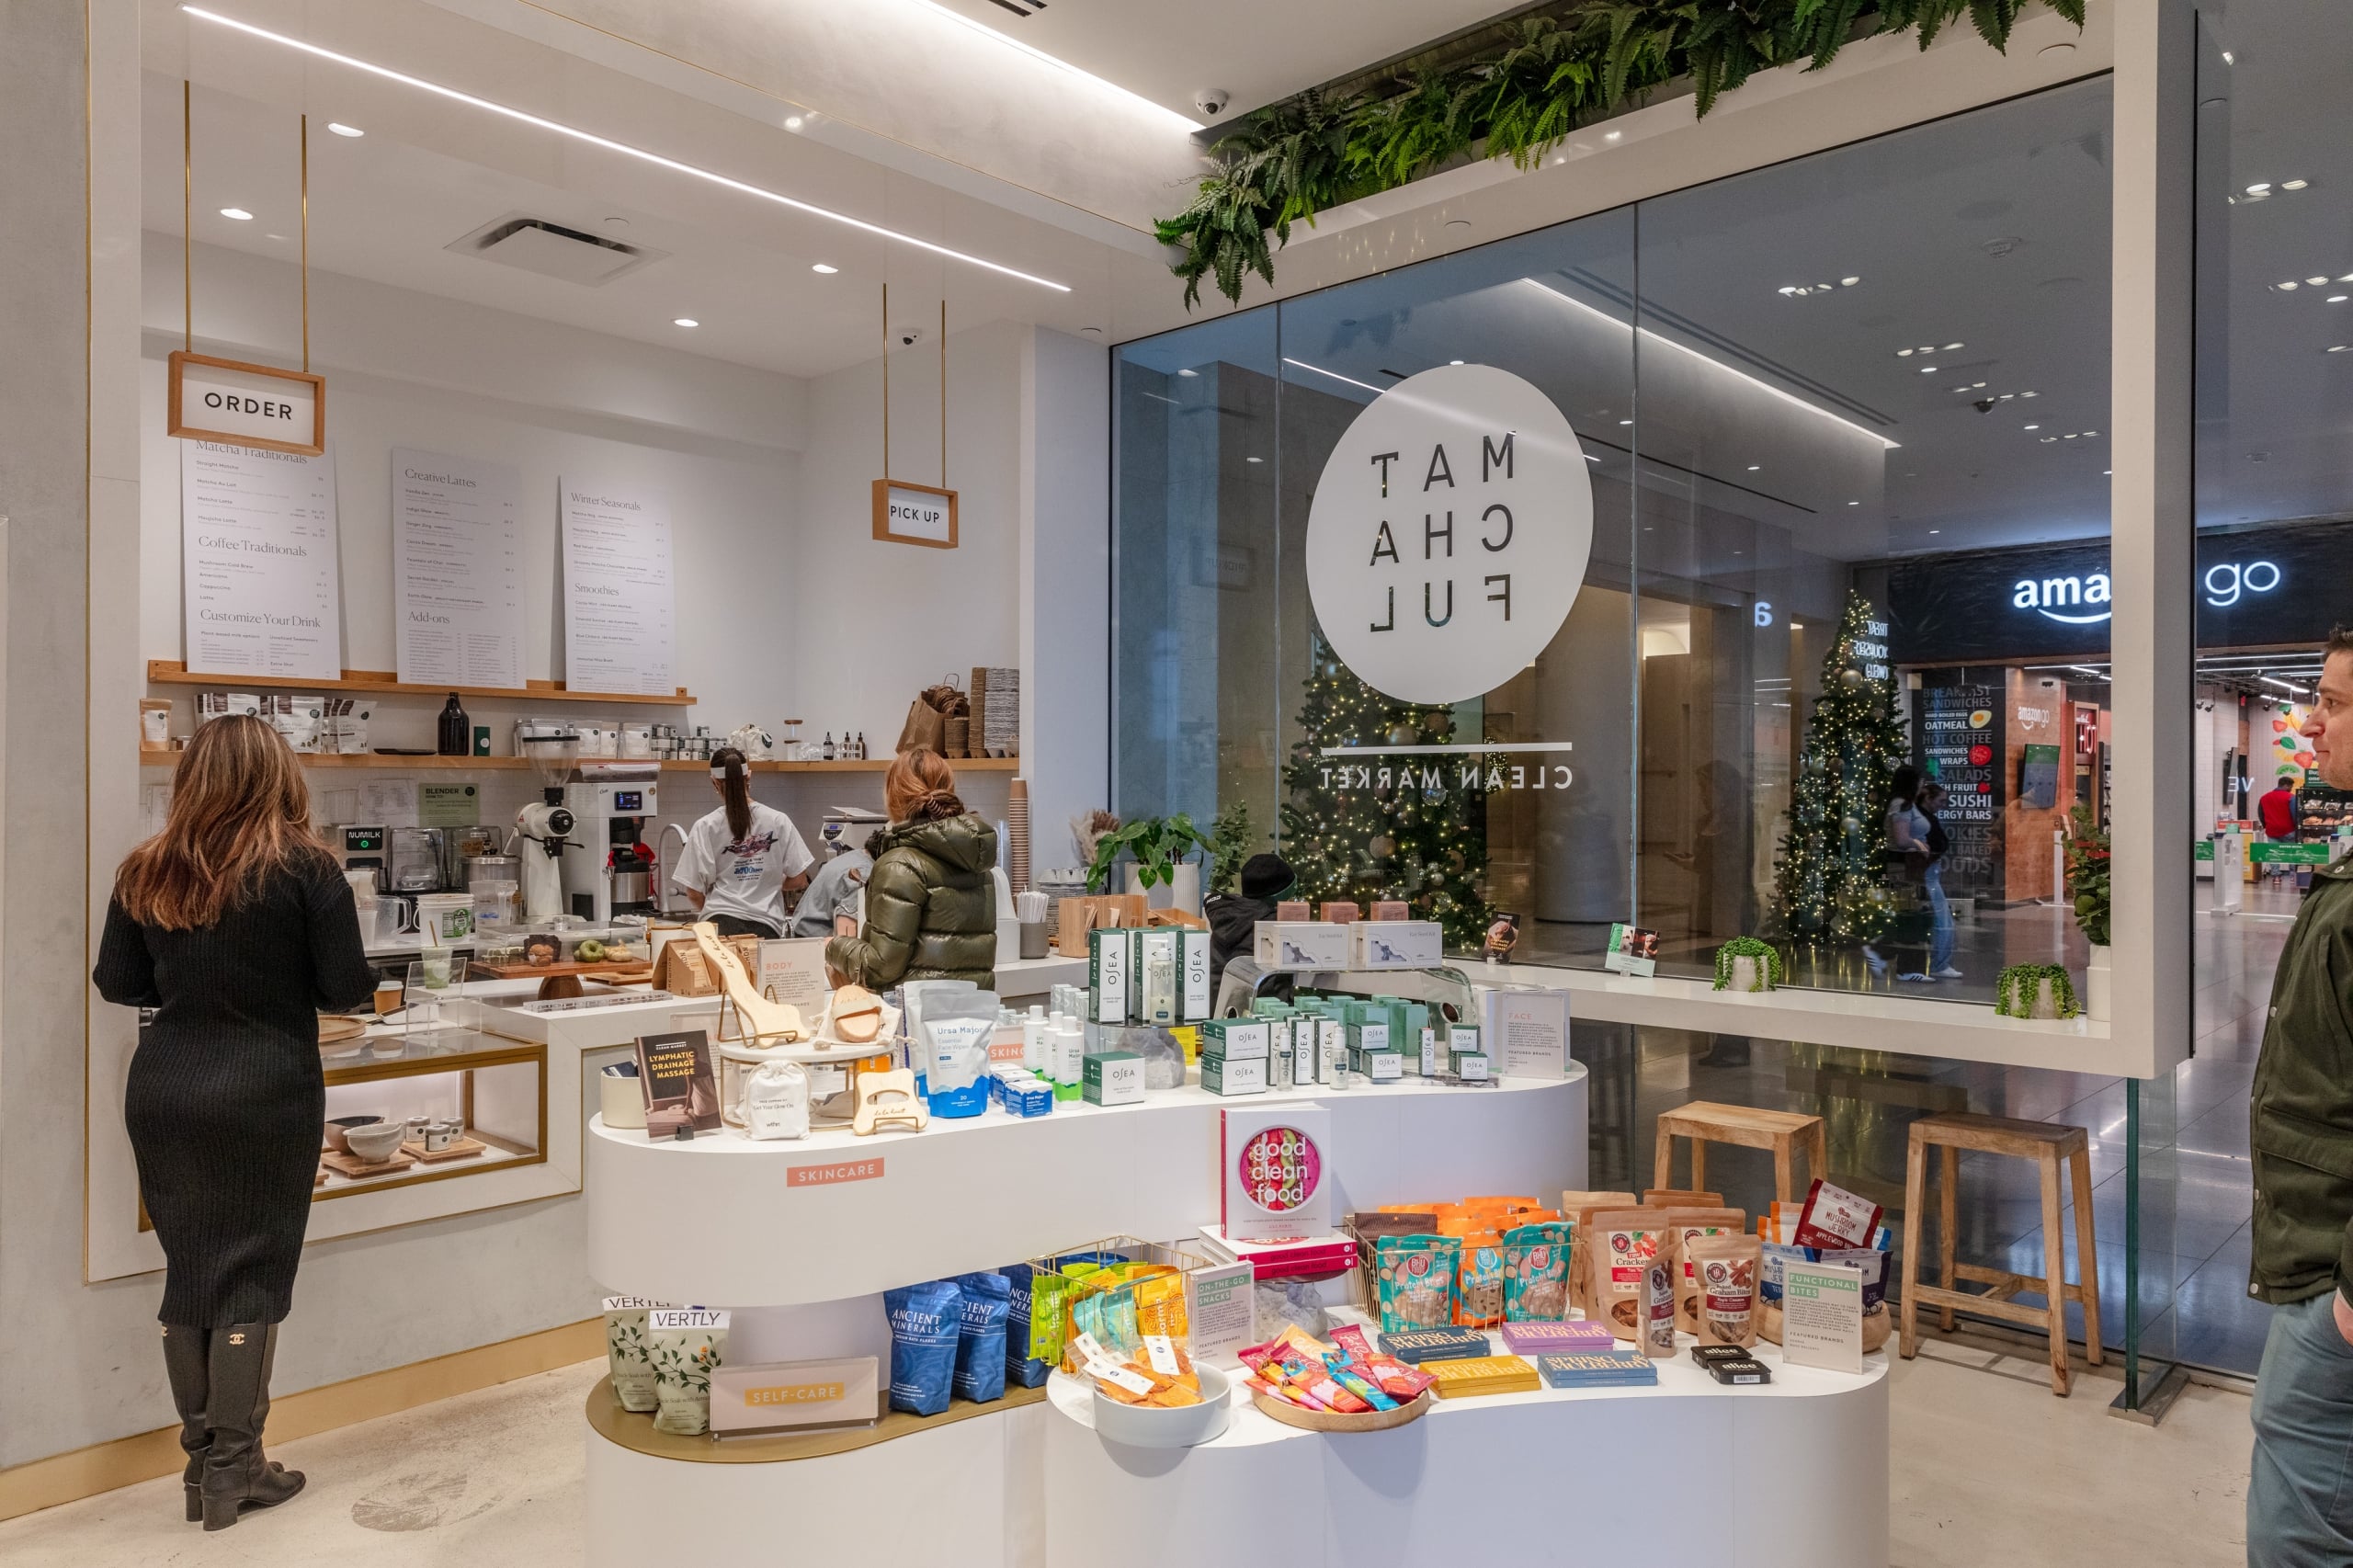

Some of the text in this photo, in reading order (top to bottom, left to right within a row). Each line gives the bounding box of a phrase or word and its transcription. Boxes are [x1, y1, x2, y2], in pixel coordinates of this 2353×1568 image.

[204, 392, 291, 420] ORDER
[196, 439, 240, 456] Matcha
[405, 469, 477, 488] Creative Lattes
[571, 492, 641, 511] Winter Seasonals
[891, 506, 939, 522] PICK UP
[199, 536, 307, 556] Coffee Traditionals
[575, 583, 619, 596] Smoothies
[2205, 561, 2280, 606] go
[2013, 574, 2111, 608] ama
[200, 609, 322, 628] Customize Your Drink
[408, 611, 450, 624] Add-ons
[1924, 698, 1992, 709] SANDWICHES
[2018, 706, 2040, 722] amazon
[1926, 721, 1968, 730] OATMEAL
[1923, 733, 1992, 744] HOT COFFEE
[1939, 769, 1992, 781] SALADS
[1949, 795, 1992, 808] SUSHI
[1934, 811, 1992, 820] ERGY BARS
[1947, 827, 1992, 840] OKIES
[1940, 857, 1992, 873] OODS
[767, 962, 792, 971] BODY
[649, 1051, 695, 1062] LYMPHATIC
[992, 1049, 1024, 1057] SKINC
[652, 1060, 695, 1071] DRAINAGE
[657, 1068, 695, 1079] MASSAGE
[1253, 1137, 1306, 1161] good
[799, 1164, 874, 1182] SKINCARE
[1251, 1161, 1308, 1180] clean
[1256, 1182, 1303, 1202] food
[1825, 1211, 1857, 1231] MUSHROOM
[1828, 1223, 1850, 1236] JERKY
[1816, 1232, 1843, 1247] APPLEWOOD
[1764, 1265, 1782, 1274] MUSHR
[1199, 1277, 1245, 1291] ON-THE-GO
[1790, 1274, 1856, 1290] FUNCTIONAL
[1010, 1290, 1030, 1303] NCIE
[1199, 1292, 1230, 1304] SNACKS
[1790, 1287, 1817, 1296] BITES
[962, 1301, 994, 1315] CIENT
[1012, 1299, 1030, 1312] NERA
[656, 1312, 721, 1326] VERTLY
[892, 1309, 941, 1324] ANCIENT
[961, 1312, 989, 1324] ERALS
[891, 1320, 940, 1334] MINERALS
[1199, 1339, 1221, 1348] FEATURED
[1387, 1332, 1452, 1343] SPRING
[1394, 1332, 1484, 1349] MULBERRY
[1546, 1355, 1614, 1366] SPRING
[1552, 1358, 1649, 1370] MULBERRY
[754, 1387, 836, 1403] SELF-CARE
